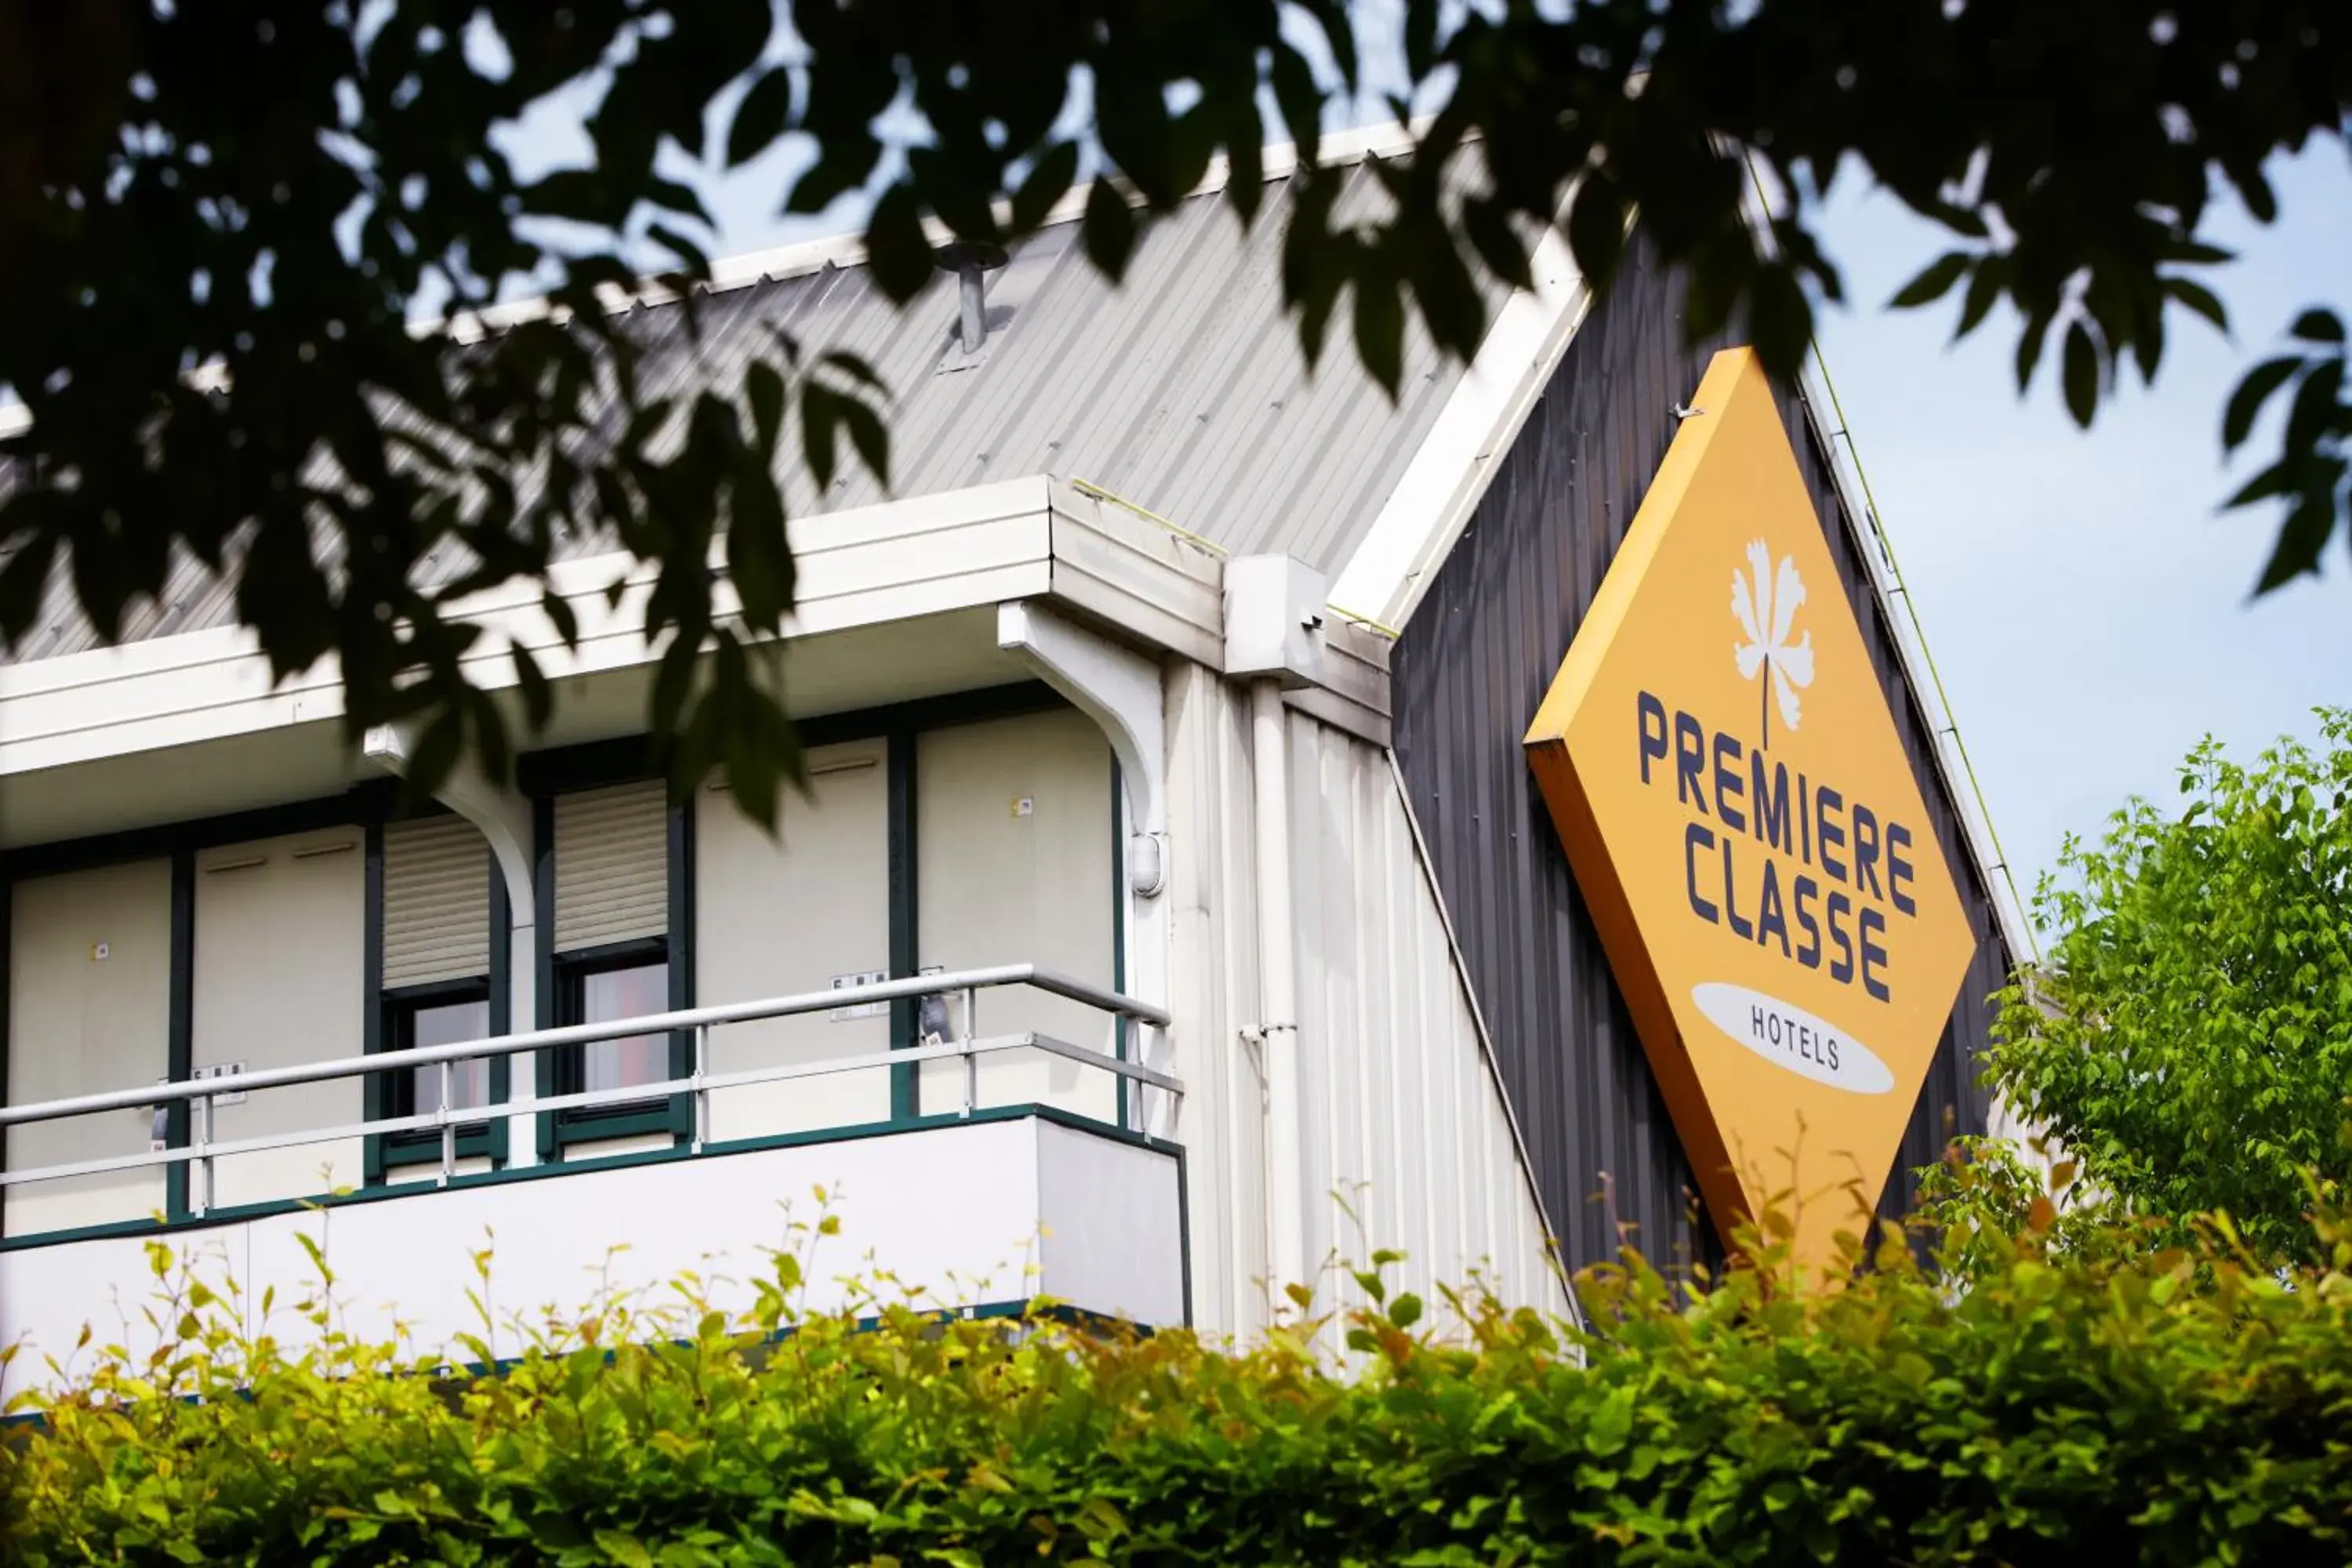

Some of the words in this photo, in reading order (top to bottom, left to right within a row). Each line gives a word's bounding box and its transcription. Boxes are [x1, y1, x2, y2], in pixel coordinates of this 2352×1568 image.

[1638, 690, 1916, 917] PREMIERE
[1685, 822, 1890, 1004] CLASSE
[1751, 1004, 1839, 1071] HOTELS
